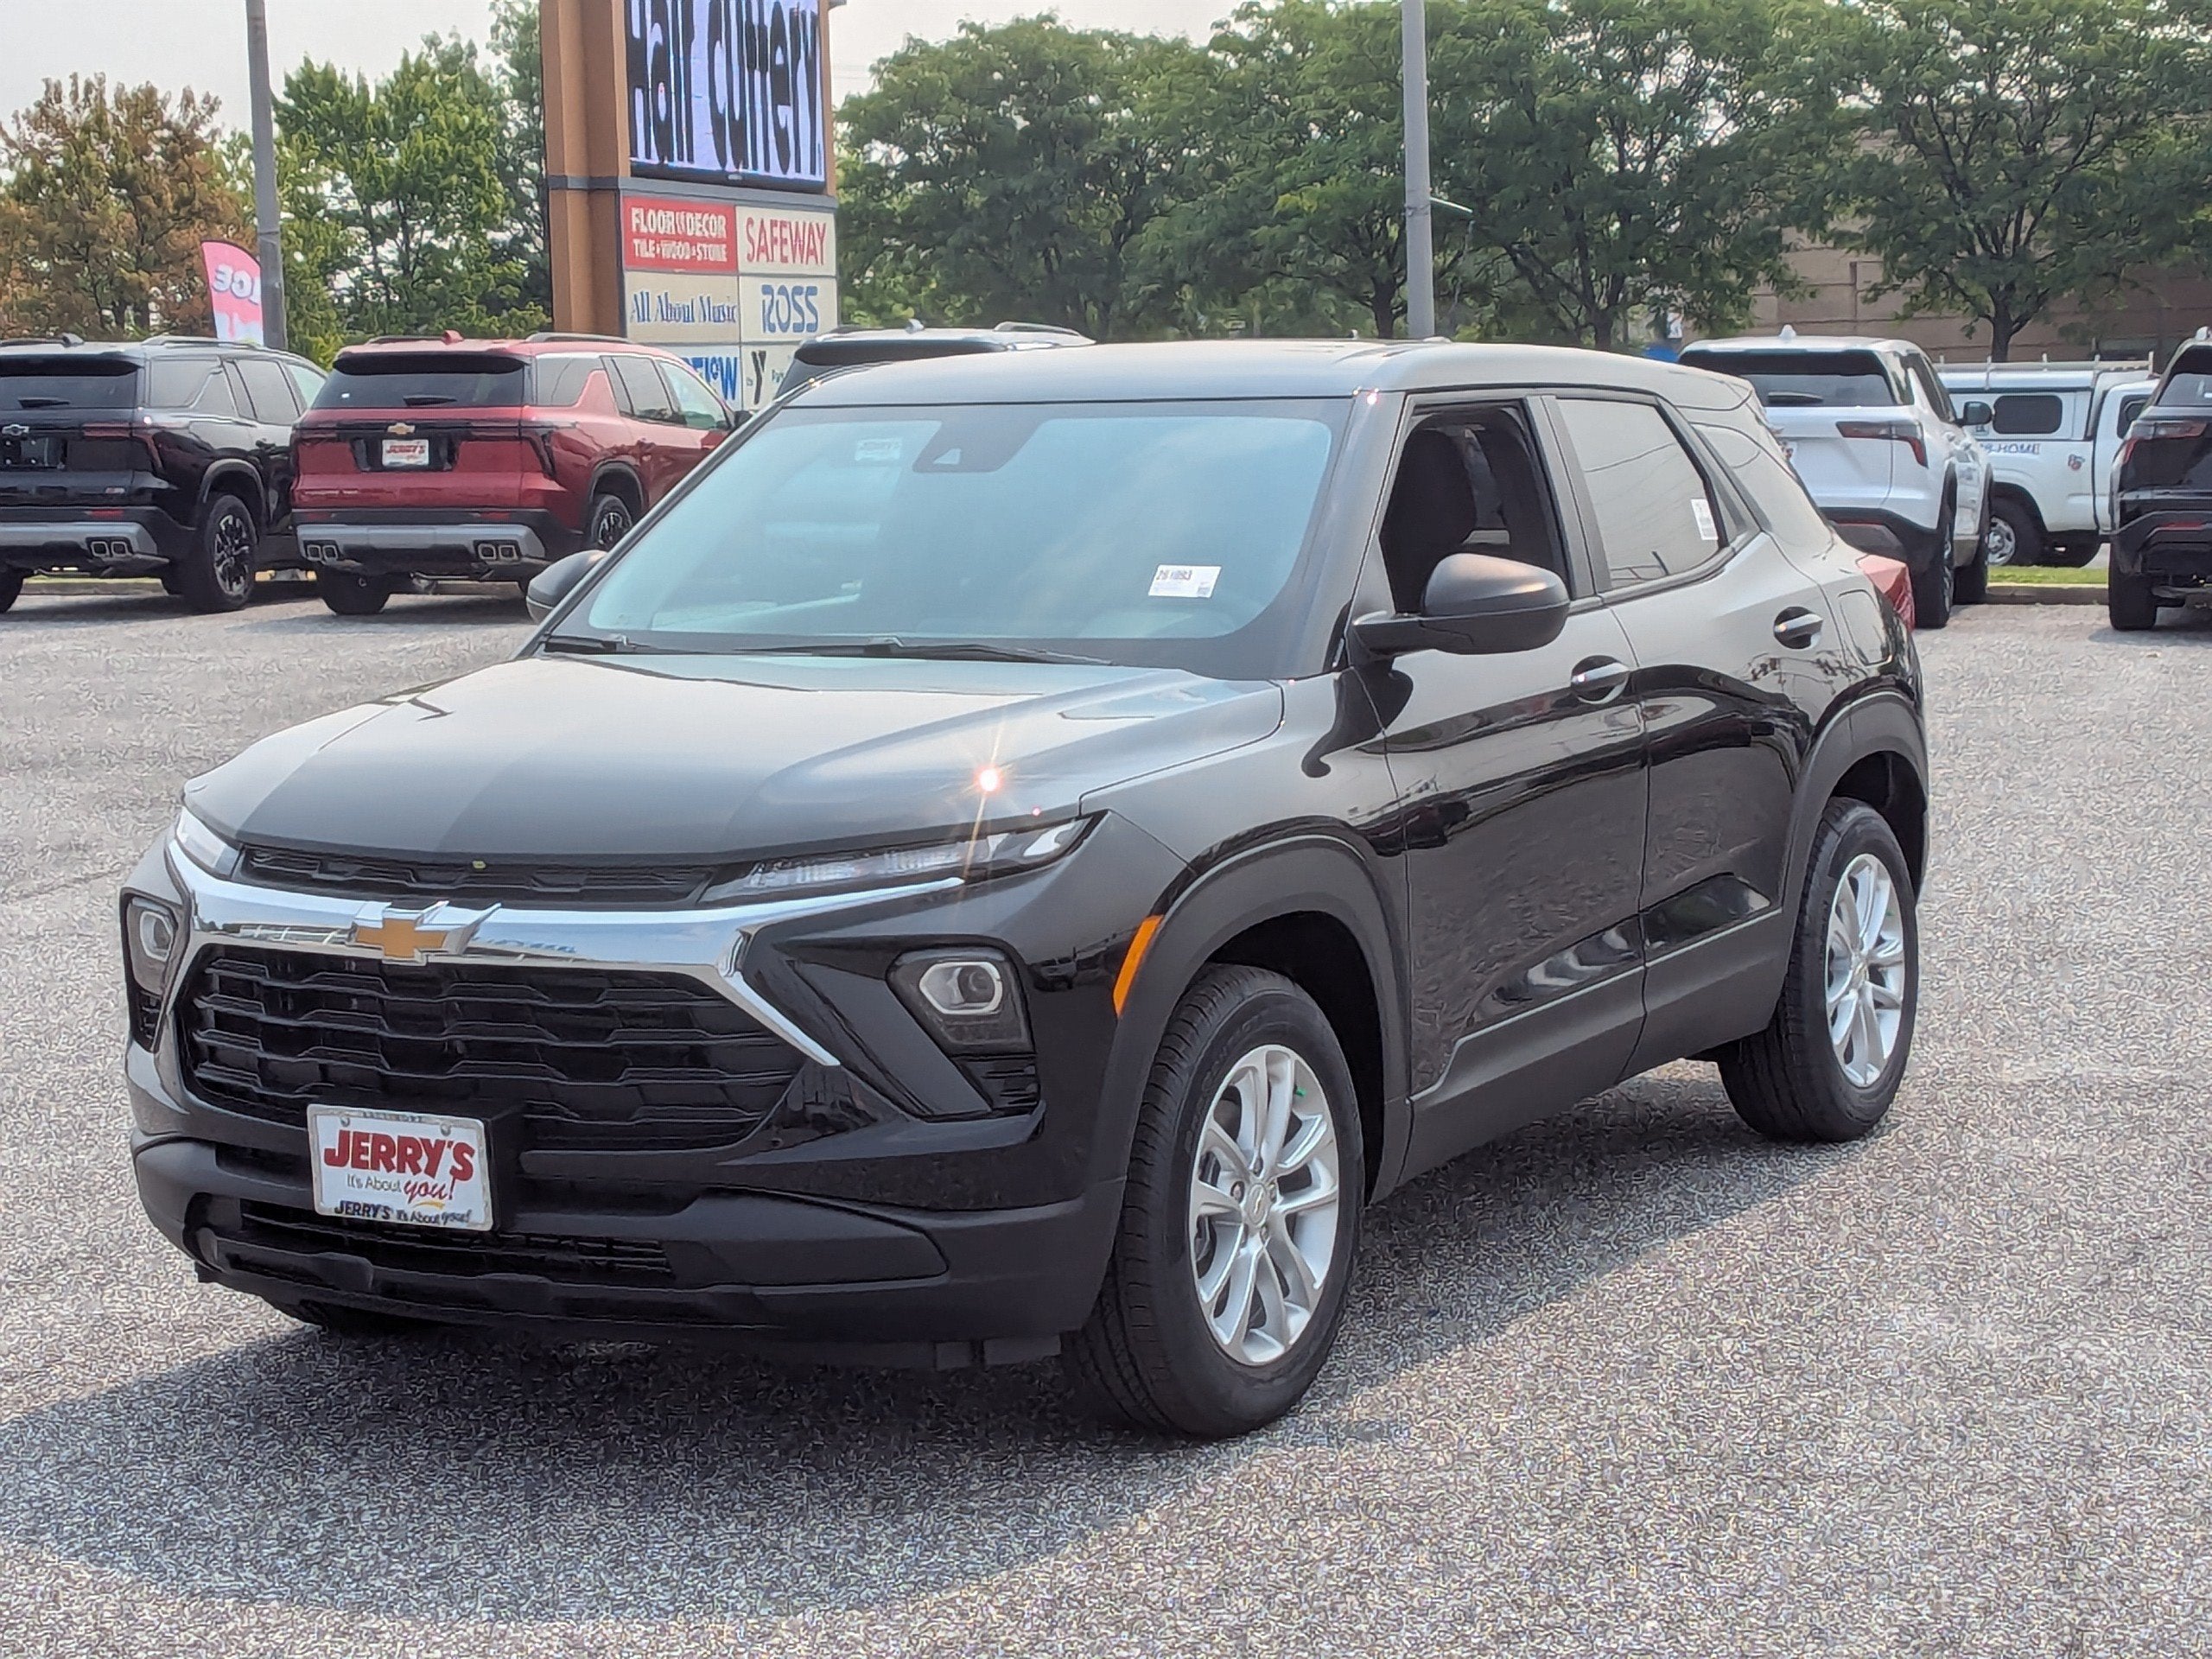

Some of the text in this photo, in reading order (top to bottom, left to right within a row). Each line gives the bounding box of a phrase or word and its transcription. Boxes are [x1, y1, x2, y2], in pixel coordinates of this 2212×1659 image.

[746, 217, 826, 265] SAFEWAY
[630, 291, 737, 323] All About Music
[761, 284, 818, 334] ROSS
[324, 1129, 475, 1181] JERRY'S
[346, 1173, 456, 1205] It's About you!
[334, 1199, 393, 1220] JERRY'S
